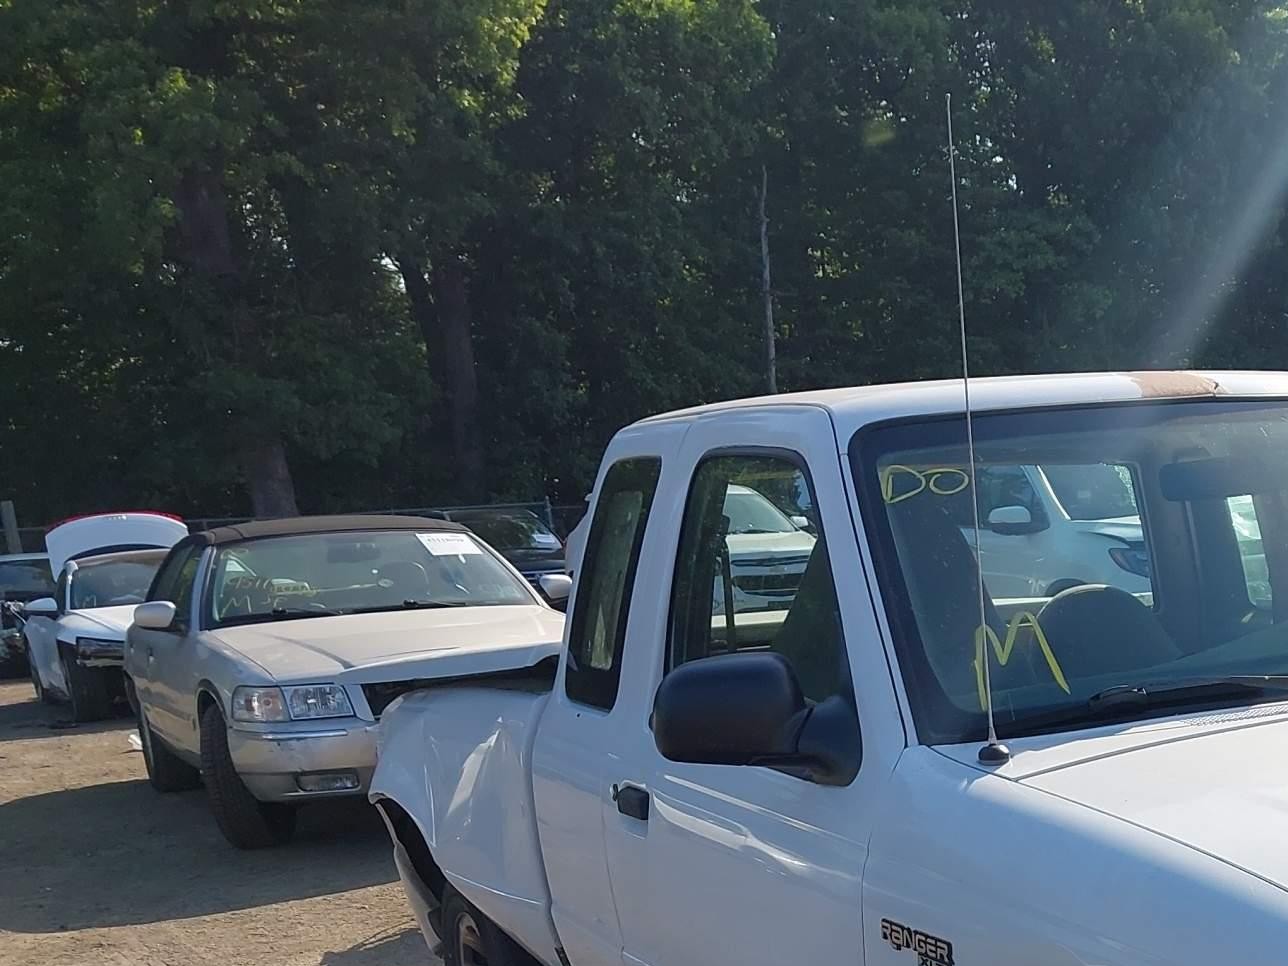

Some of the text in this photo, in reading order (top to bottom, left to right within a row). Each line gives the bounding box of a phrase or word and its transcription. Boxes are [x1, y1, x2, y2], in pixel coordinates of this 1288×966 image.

[879, 464, 969, 504] DO
[974, 611, 1072, 713] M
[881, 918, 951, 965] RANGER
